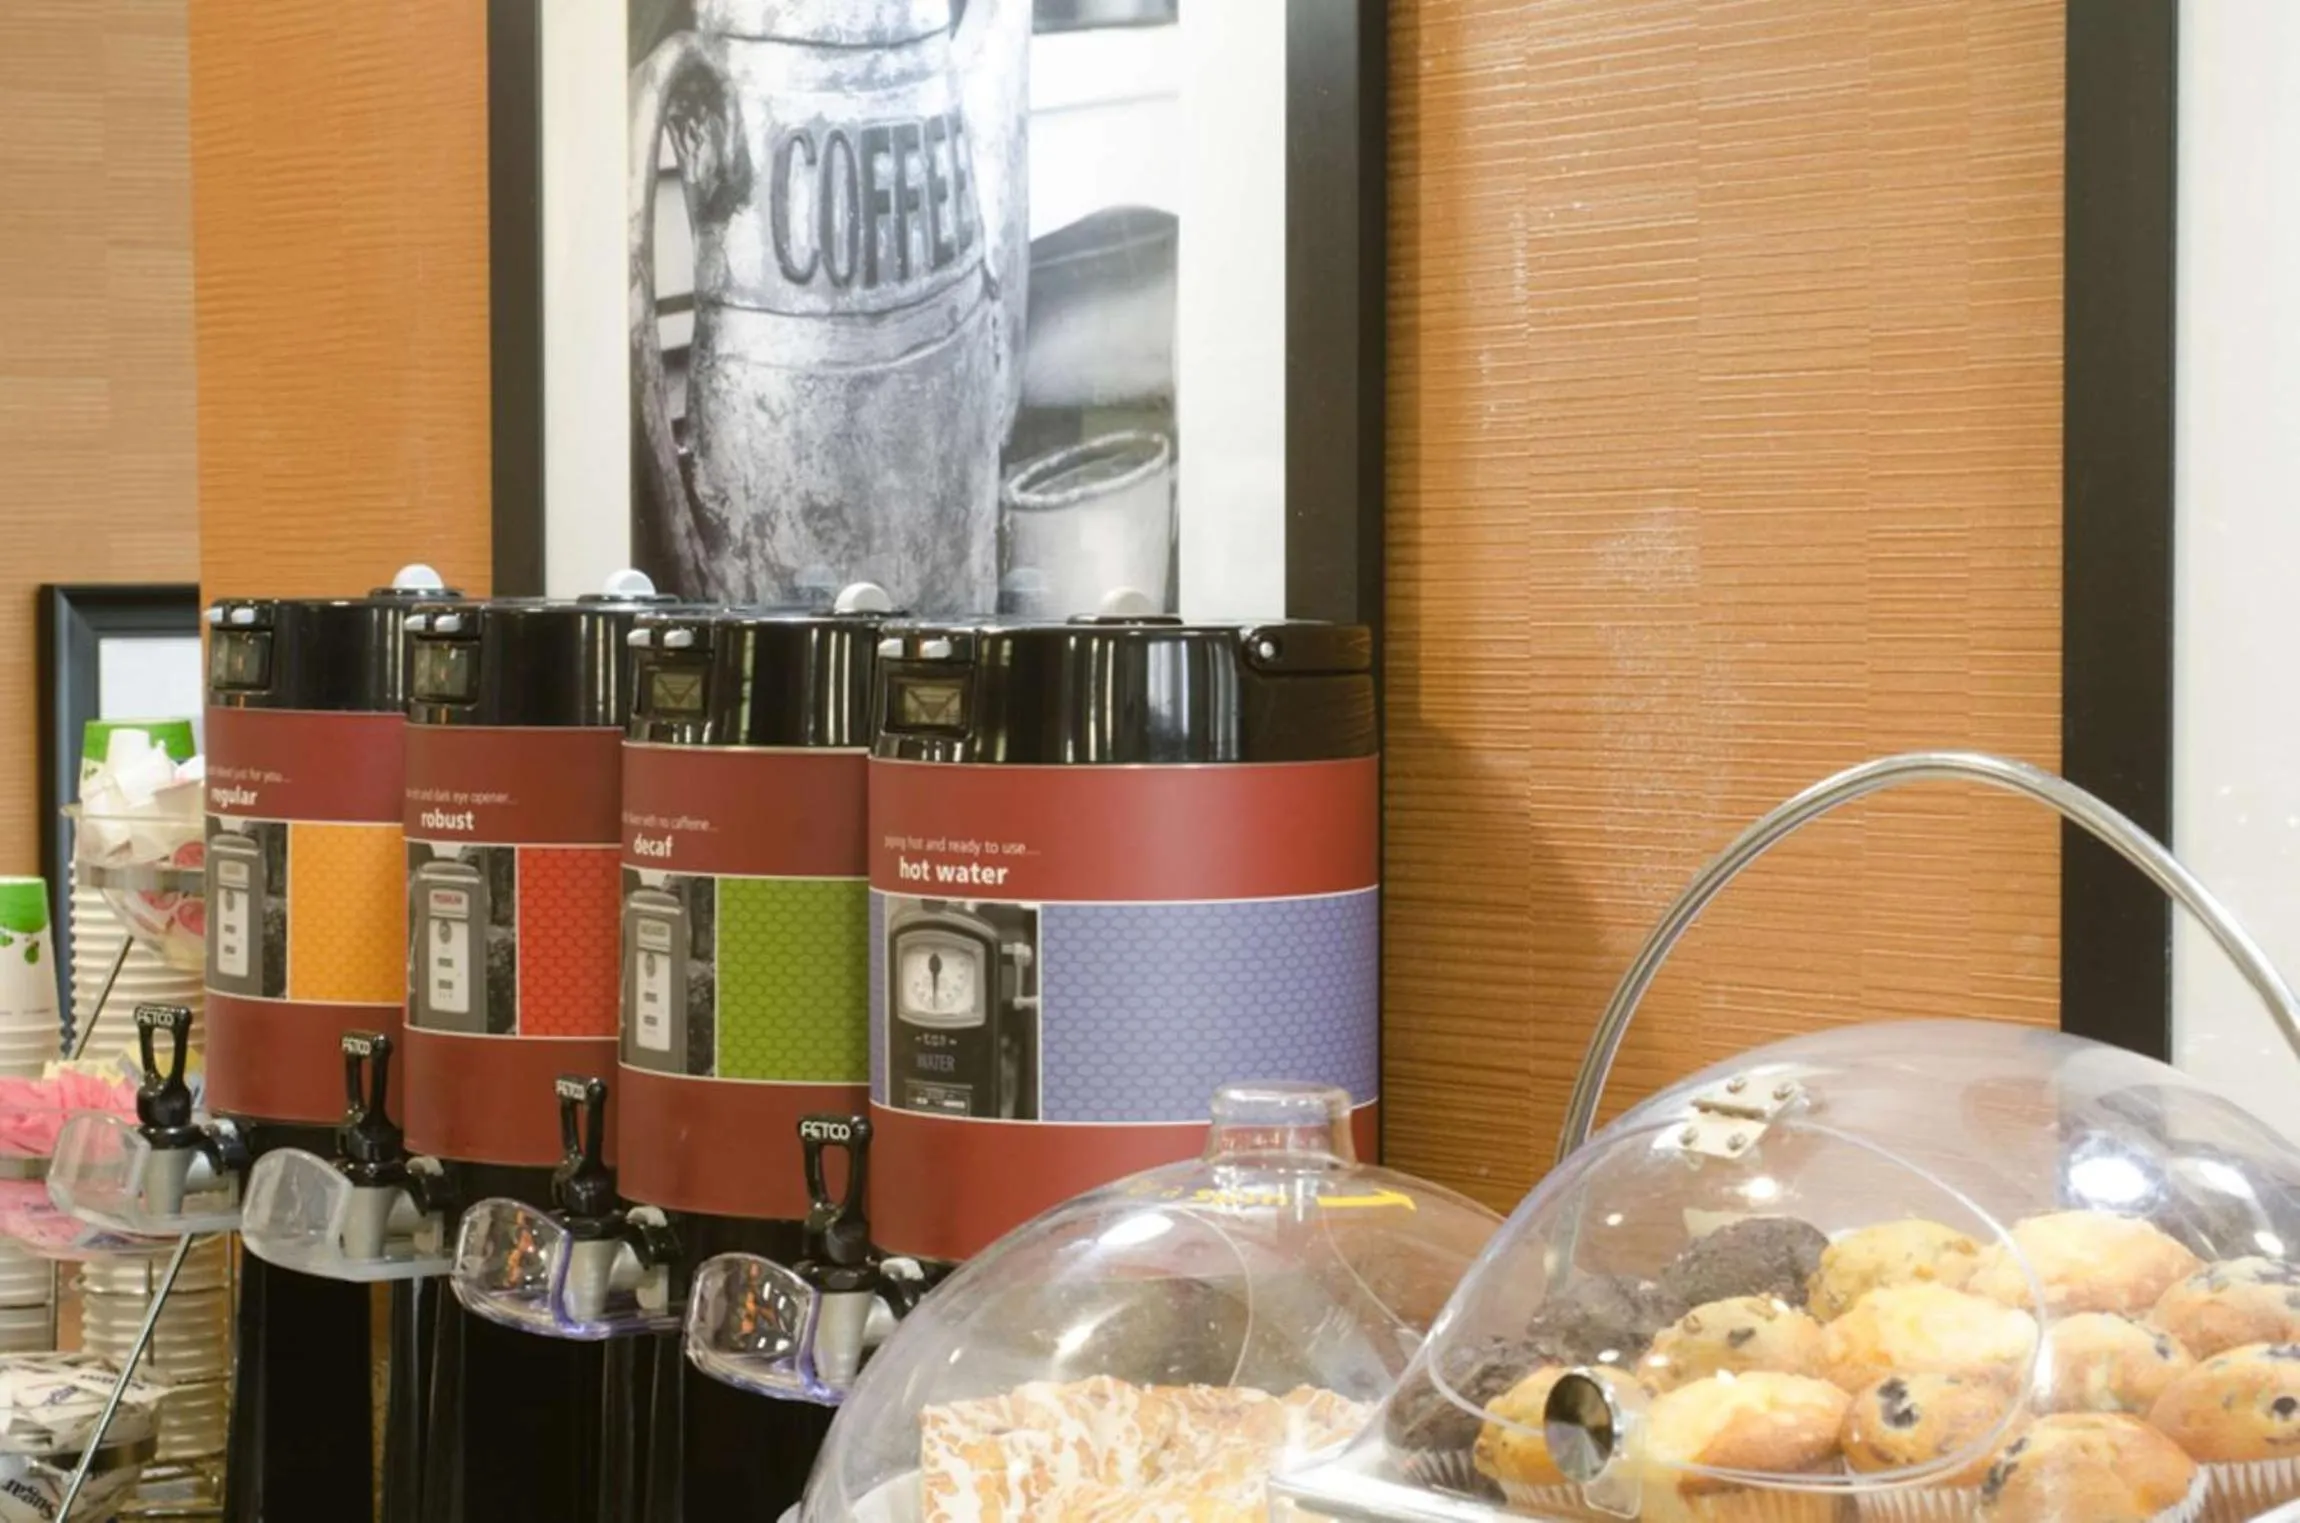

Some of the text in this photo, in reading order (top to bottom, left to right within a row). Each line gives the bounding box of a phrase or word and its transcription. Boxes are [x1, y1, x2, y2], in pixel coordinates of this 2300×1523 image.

[769, 114, 975, 290] COFFEE
[421, 808, 474, 831] robust
[633, 832, 673, 858] decaf
[926, 837, 946, 851] and
[948, 838, 982, 857] ready
[985, 840, 999, 854] to
[899, 855, 1009, 885] hot water
[801, 1120, 851, 1140] FETCO
